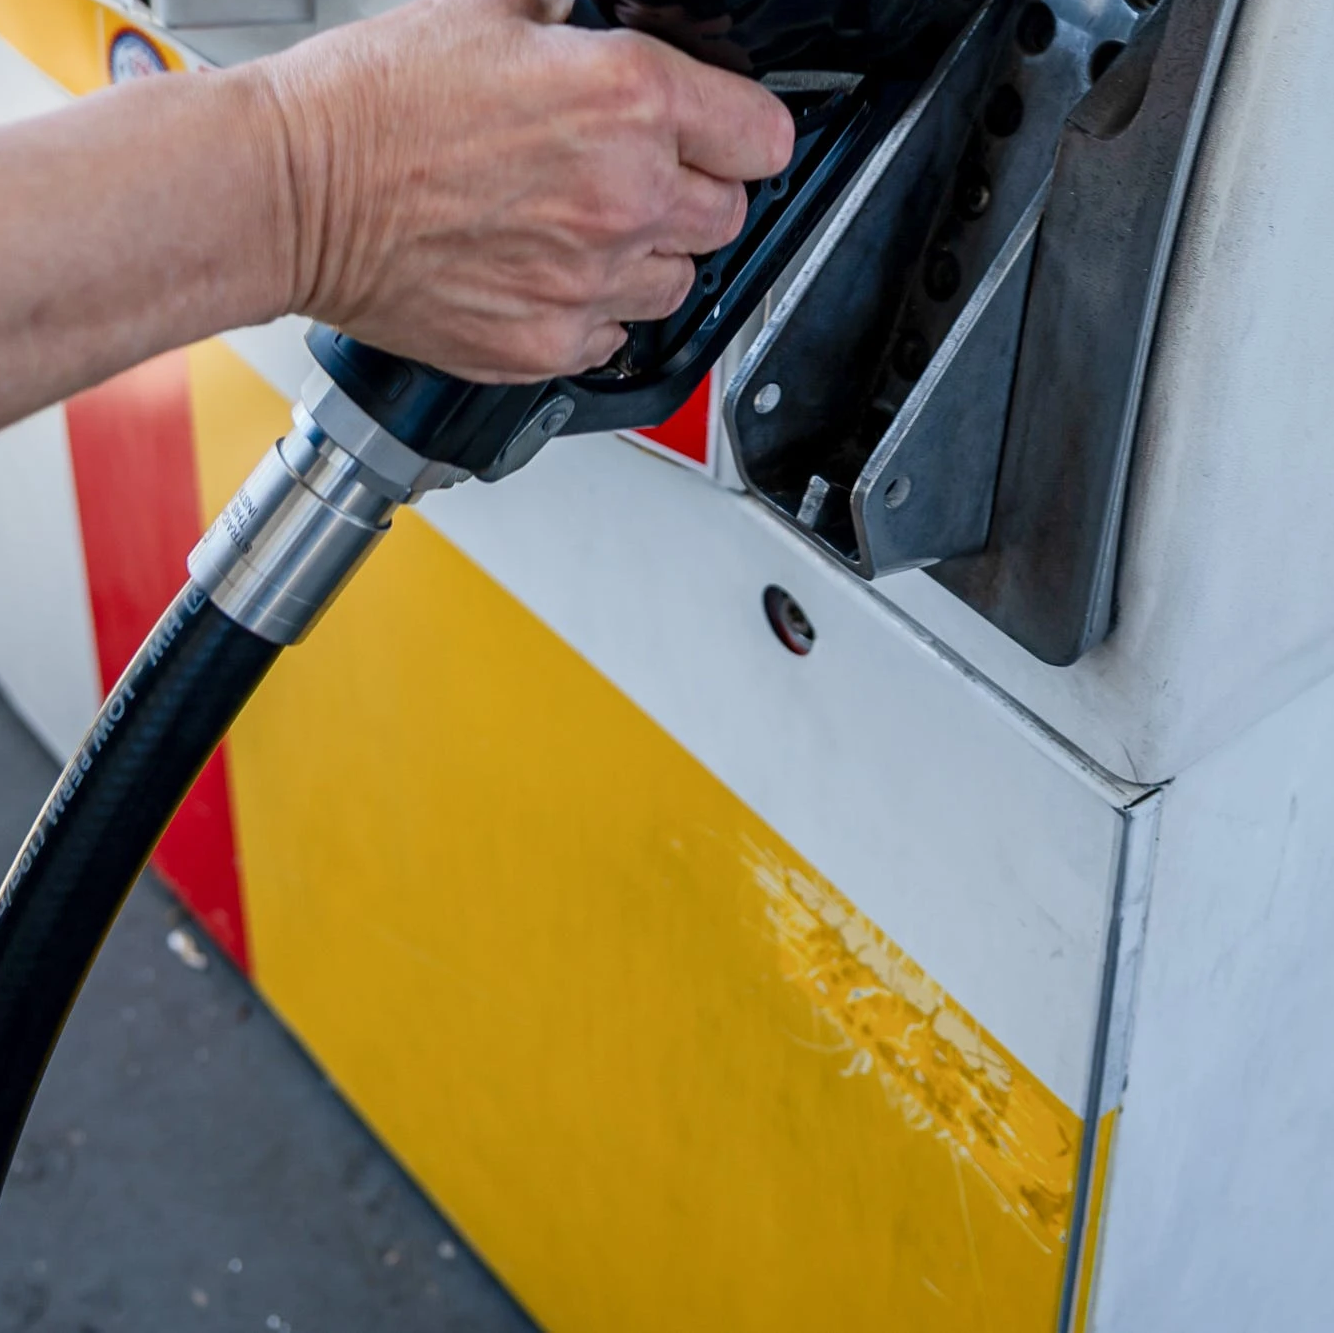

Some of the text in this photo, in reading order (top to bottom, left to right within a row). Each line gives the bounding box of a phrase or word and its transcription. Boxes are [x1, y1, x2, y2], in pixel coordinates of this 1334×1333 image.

[147, 608, 185, 669] HW
[91, 679, 136, 754] LOW
[45, 746, 94, 827] PERM
